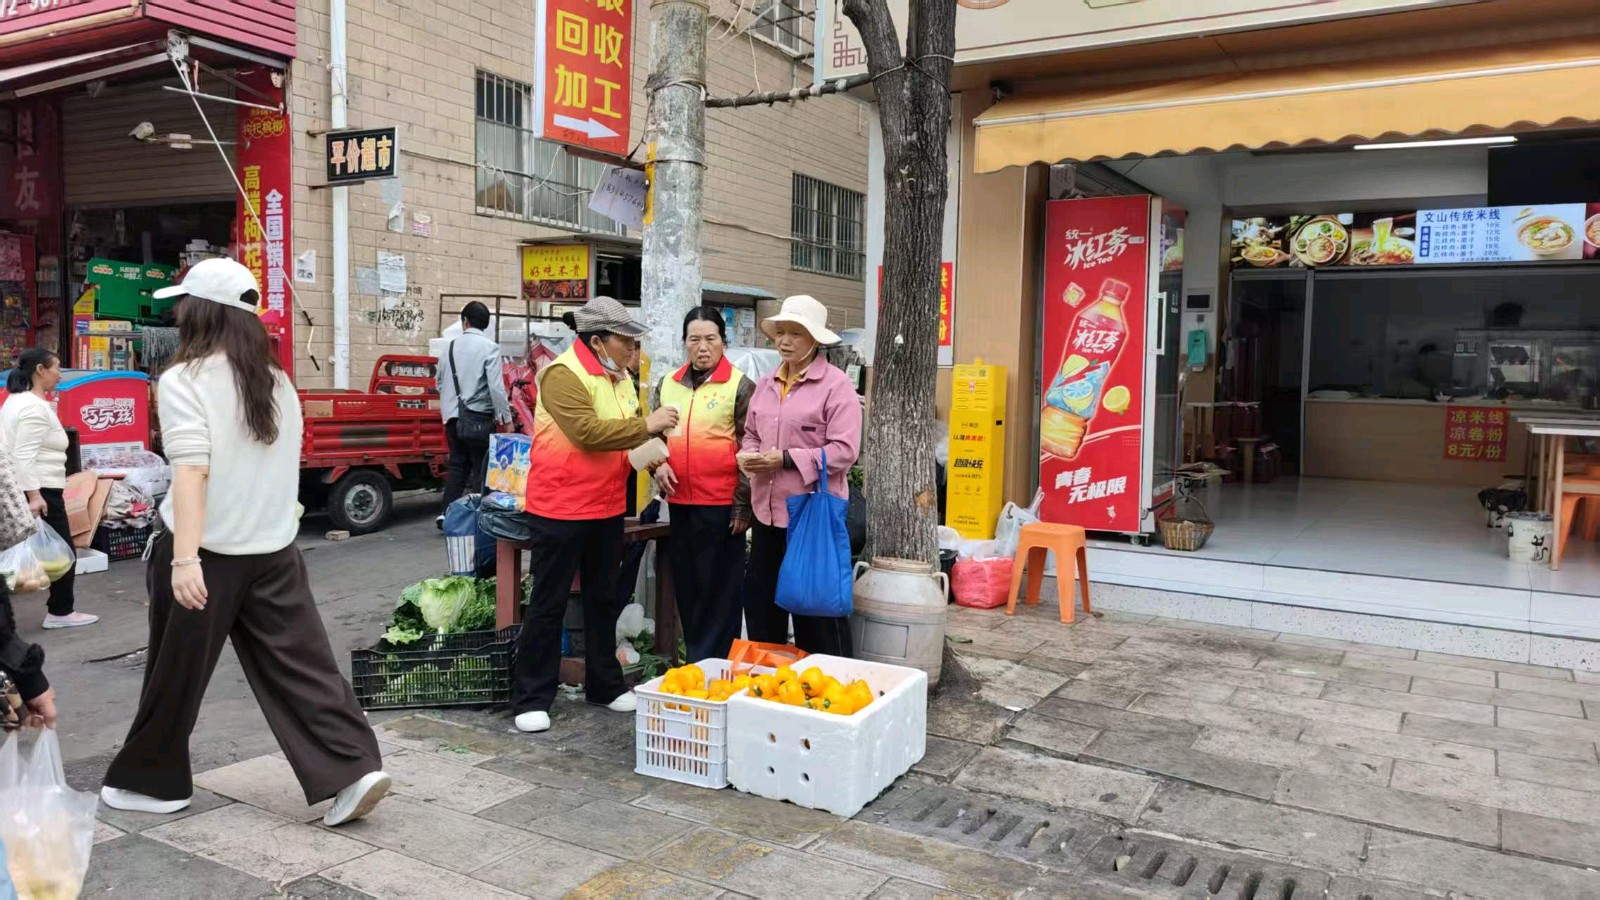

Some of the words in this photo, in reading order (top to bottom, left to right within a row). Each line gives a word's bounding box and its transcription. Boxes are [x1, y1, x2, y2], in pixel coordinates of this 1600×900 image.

[556, 9, 624, 69] 回收
[554, 63, 622, 119] 加工
[330, 134, 393, 176] 平价超市
[1424, 208, 1501, 223] 文山传统米线
[1065, 229, 1092, 240] 统一
[1064, 226, 1131, 270] 冰红茶
[265, 188, 285, 335] 全国销量第
[1083, 261, 1096, 270] Ice
[1097, 256, 1113, 265] Tea
[1071, 329, 1120, 352] 冰红茶
[82, 405, 134, 431] 巧乐兹
[1451, 409, 1504, 425] 凉米线
[1449, 427, 1503, 442] 凉卷粉
[1448, 443, 1501, 459] 8元/份
[1055, 466, 1092, 490] 青春
[1067, 476, 1127, 504] 无极限
